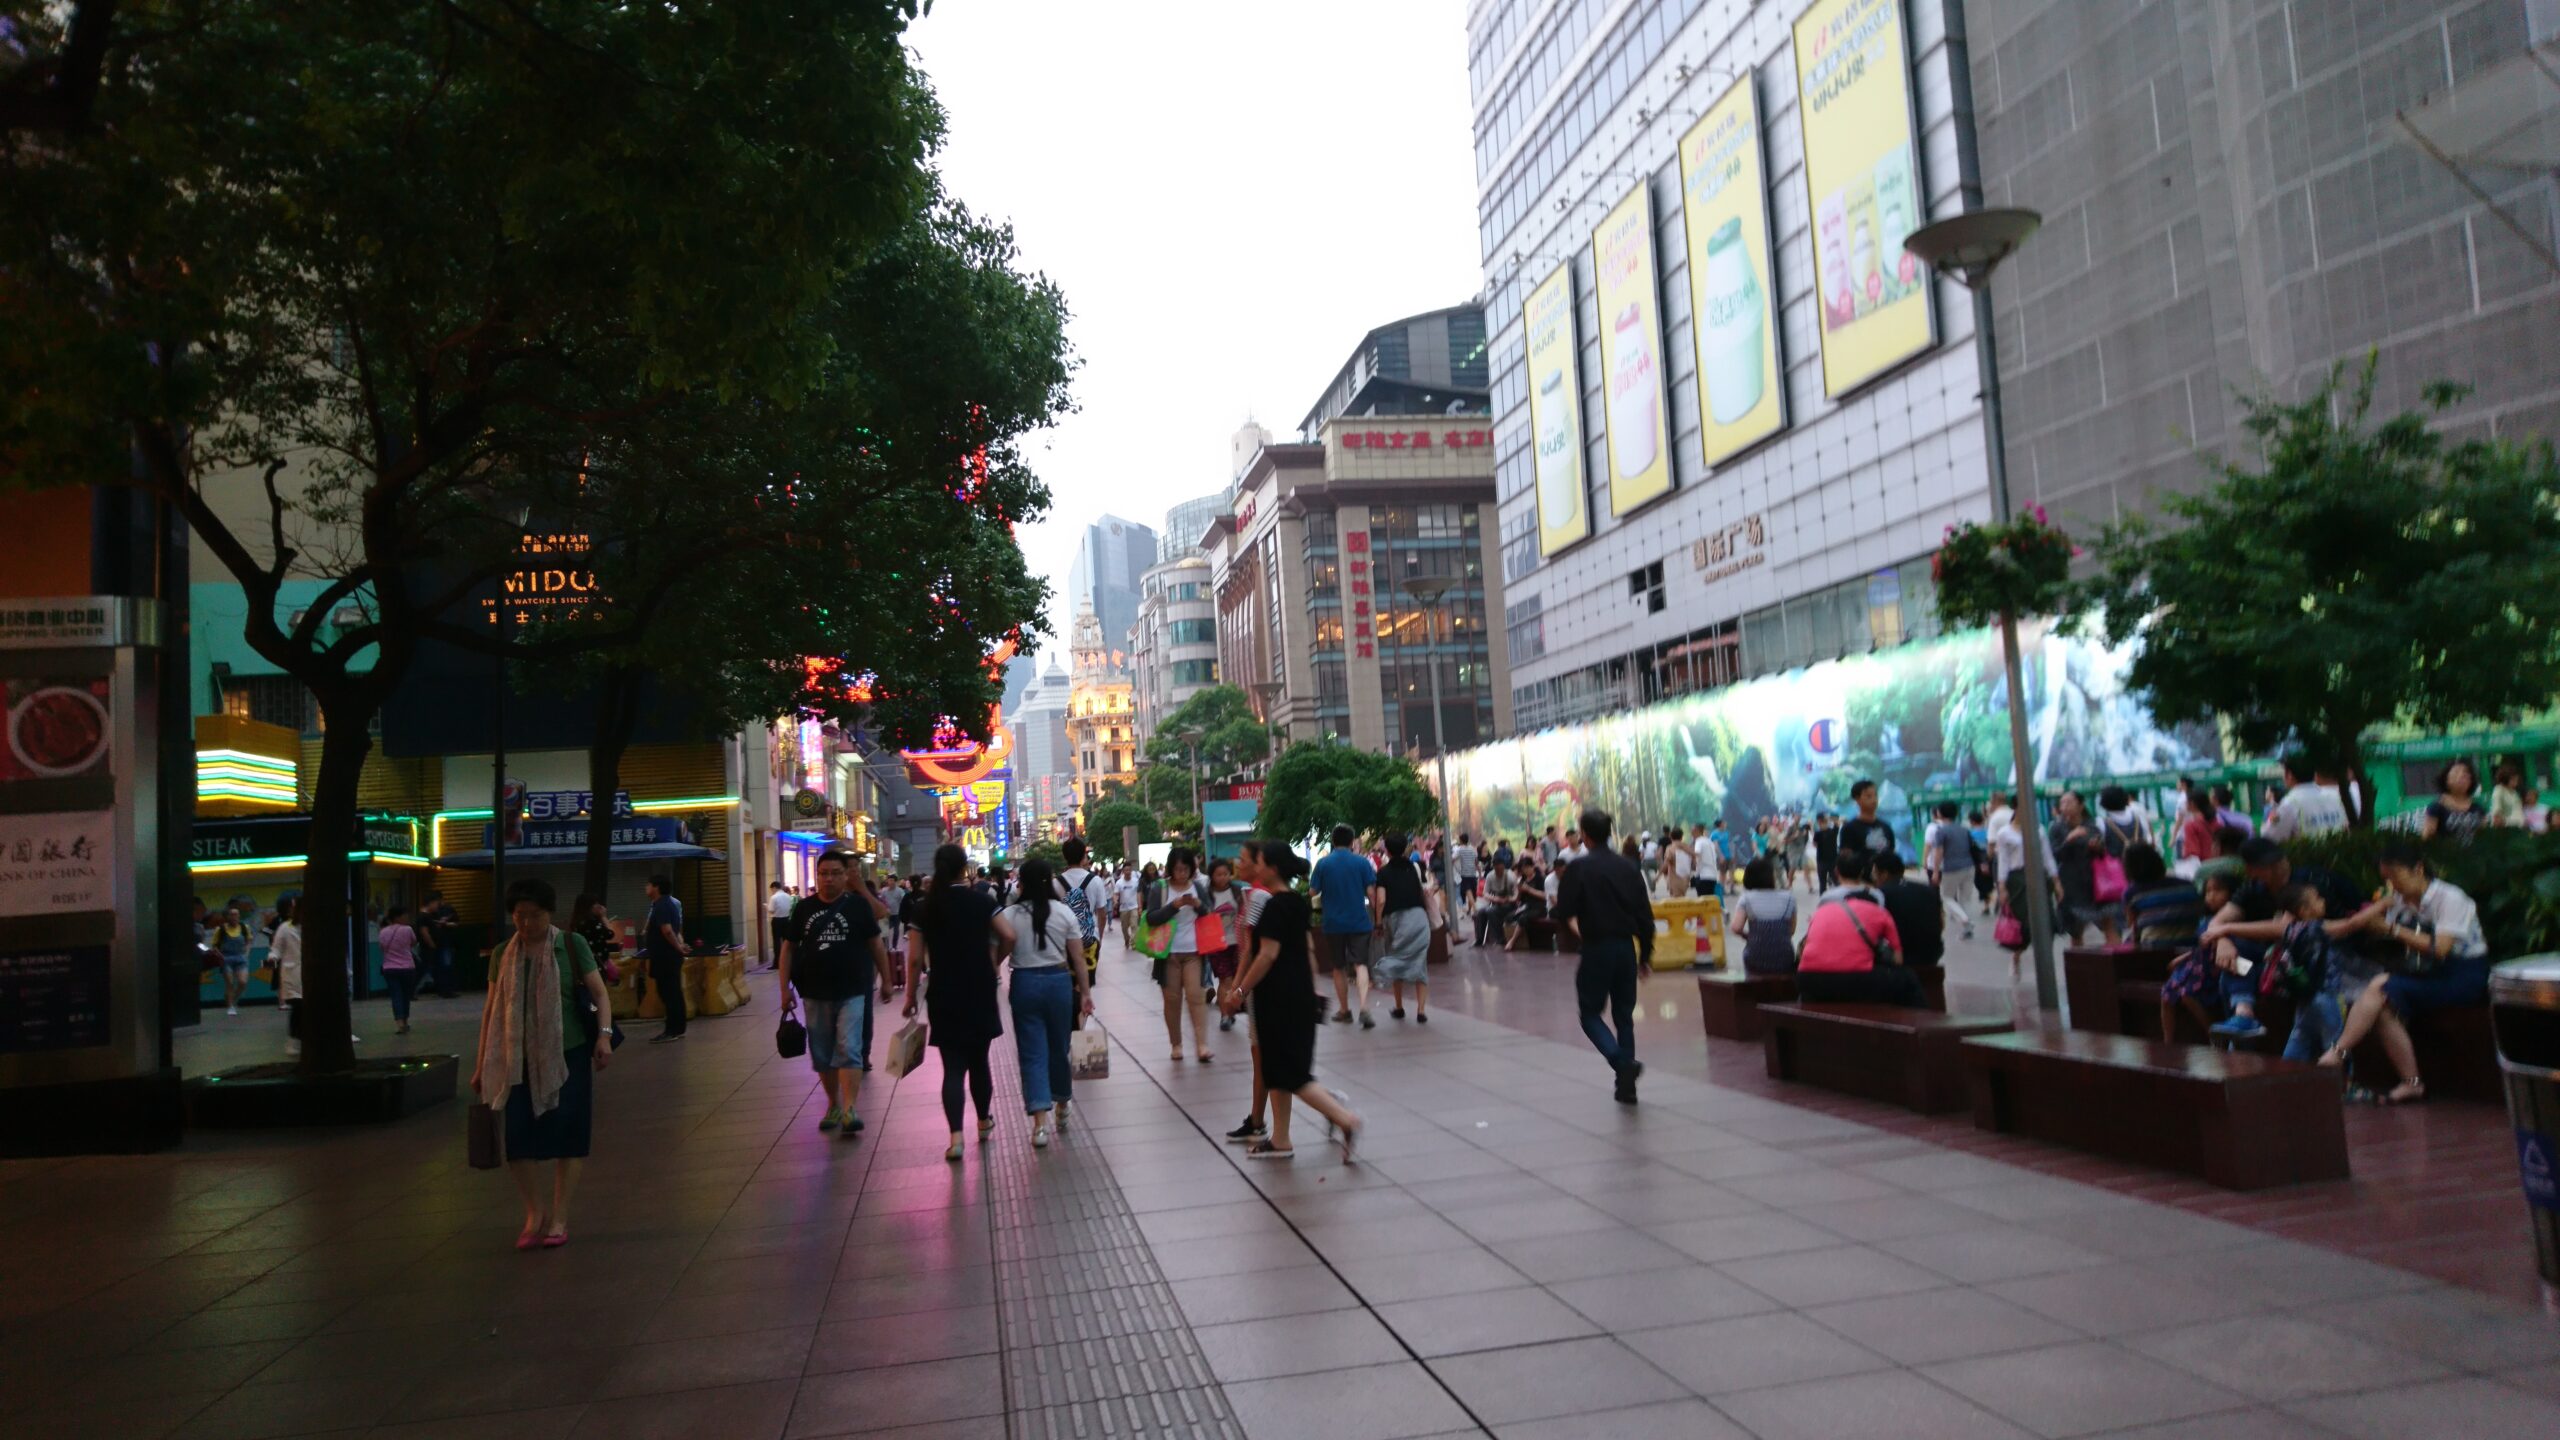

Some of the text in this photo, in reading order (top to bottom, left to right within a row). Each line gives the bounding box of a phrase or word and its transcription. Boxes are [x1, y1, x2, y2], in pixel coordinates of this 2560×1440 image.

[504, 570, 595, 593] MIDO
[481, 597, 510, 606] SWS
[514, 597, 557, 605] WATCHES
[530, 828, 657, 845] 南京东路街区服务亭
[192, 837, 253, 857] STEAK
[50, 866, 96, 878] CHINA
